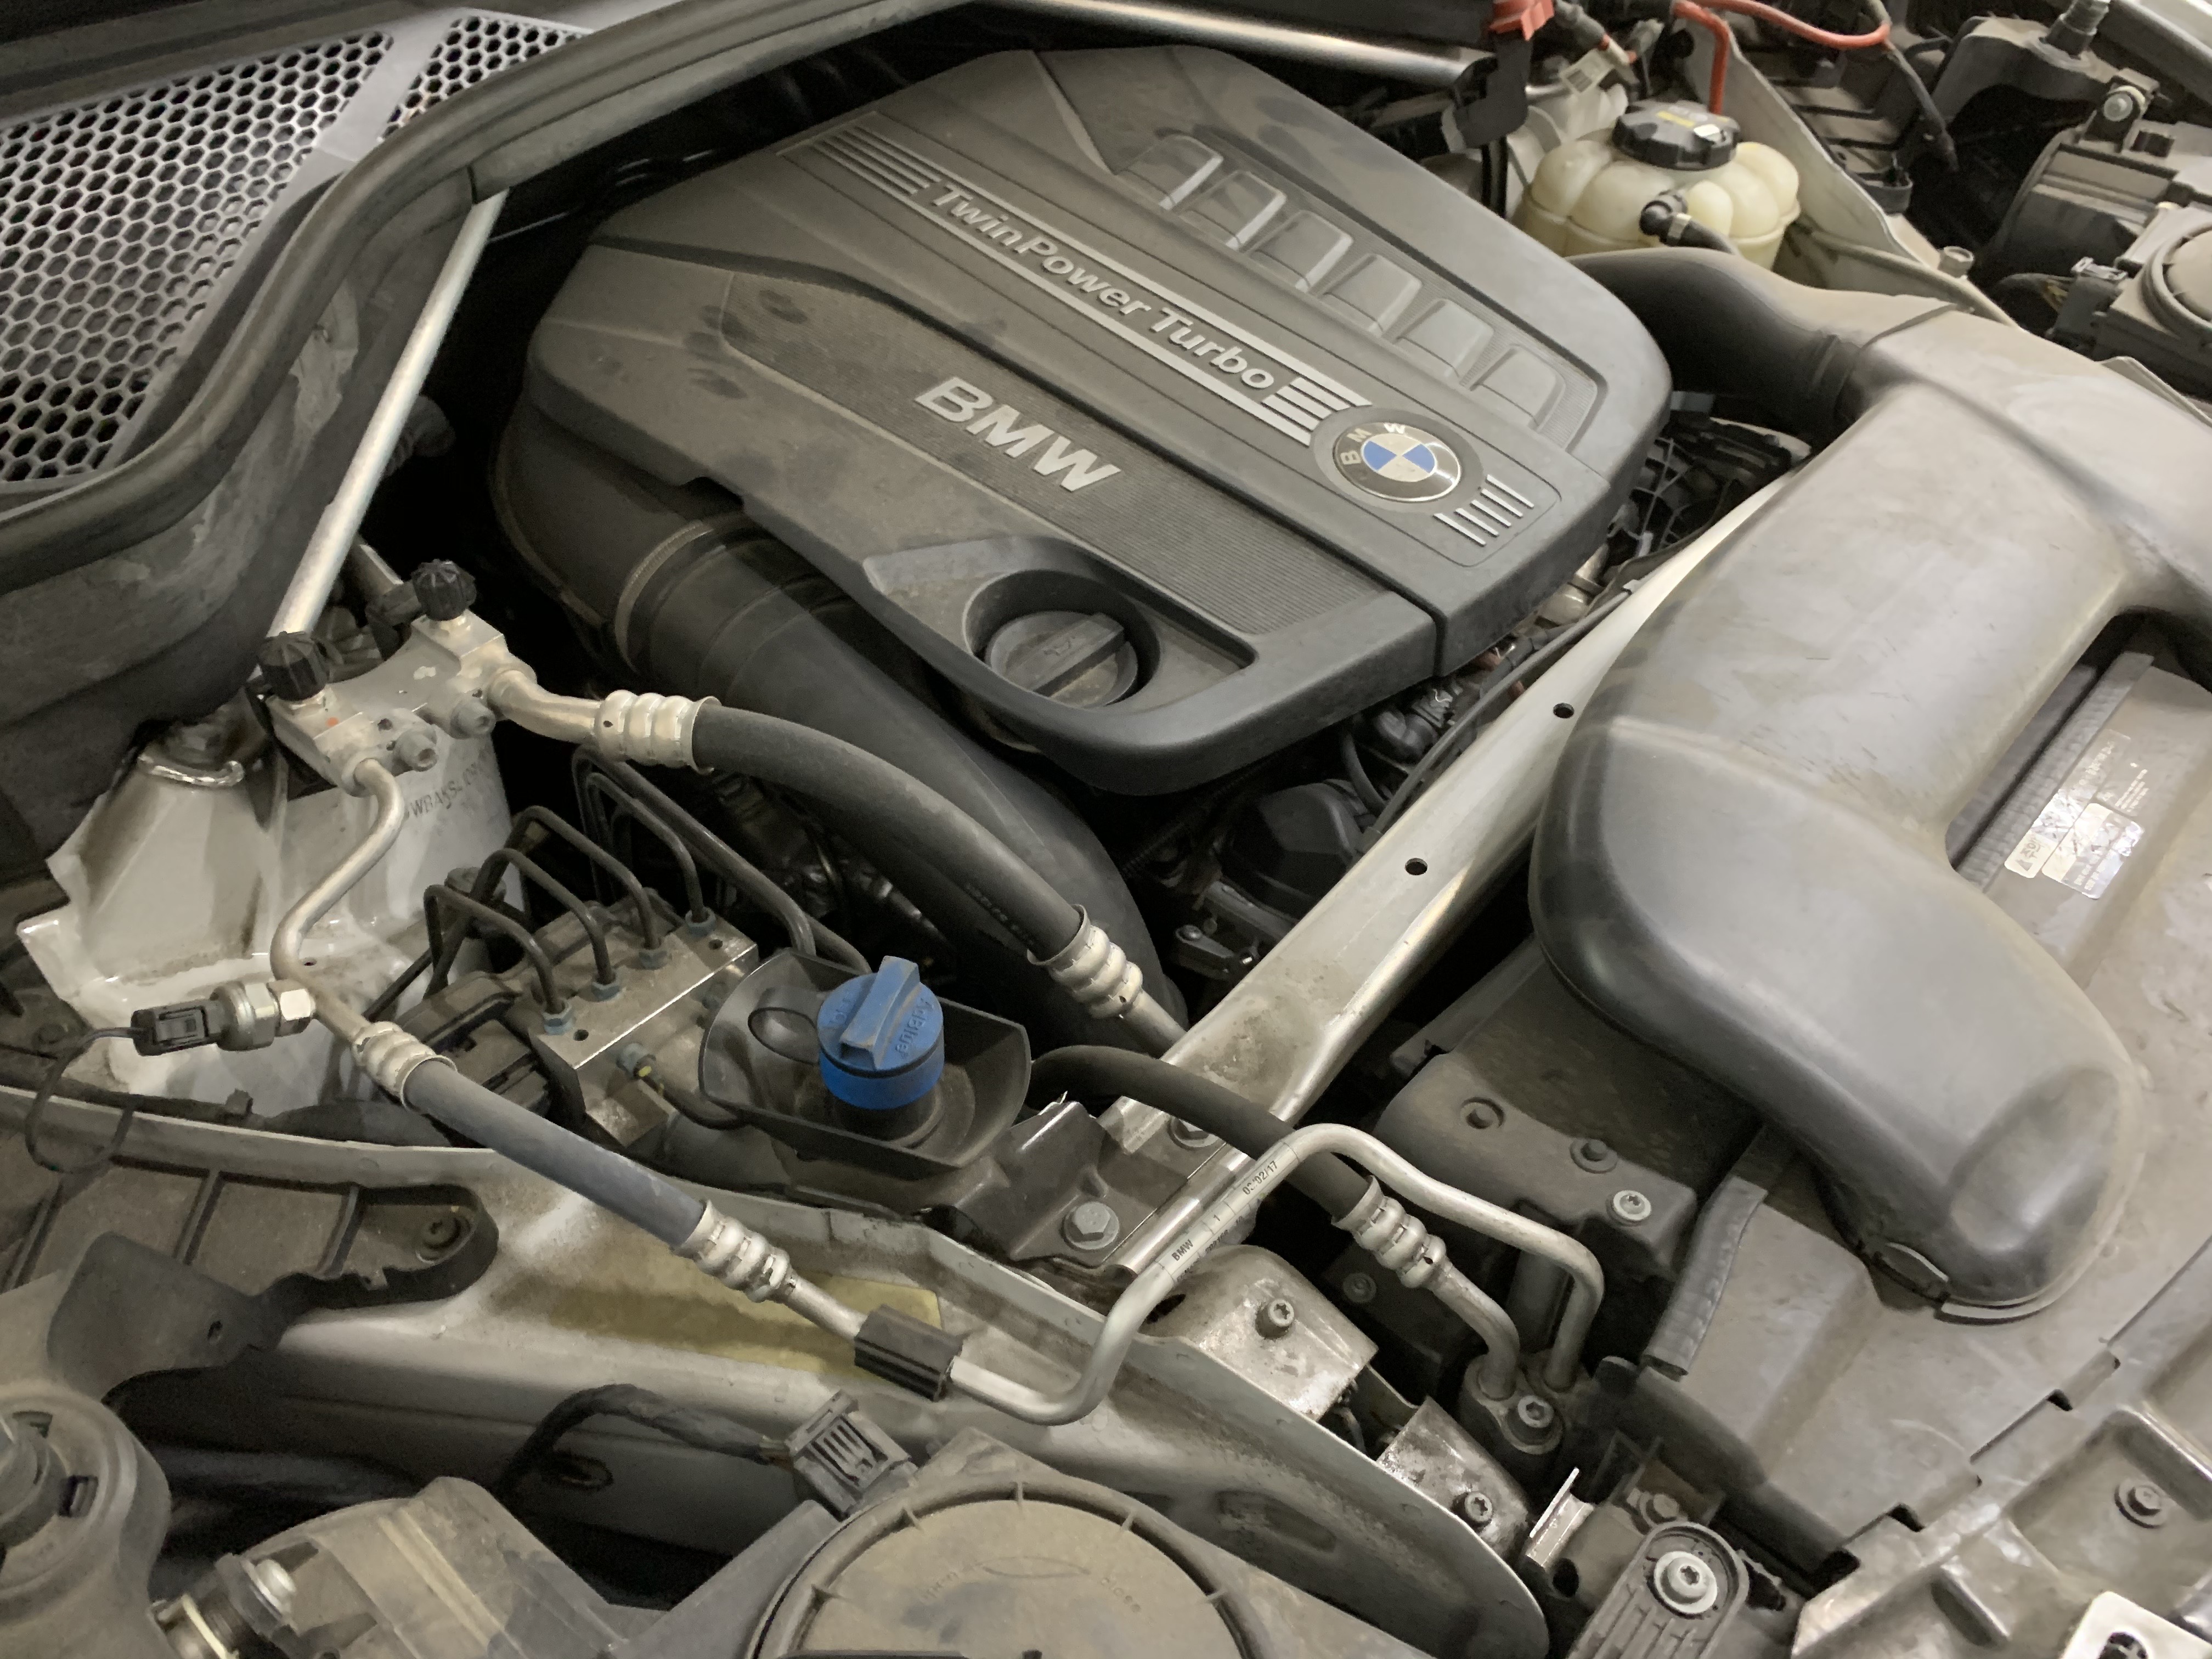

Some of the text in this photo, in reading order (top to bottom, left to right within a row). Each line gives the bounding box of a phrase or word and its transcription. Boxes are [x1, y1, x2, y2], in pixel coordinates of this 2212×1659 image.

[932, 183, 1276, 390] TwinPower Turbo
[913, 376, 1122, 493] BMW
[1340, 421, 1406, 465] BMW
[1171, 1239, 1194, 1261] BMW
